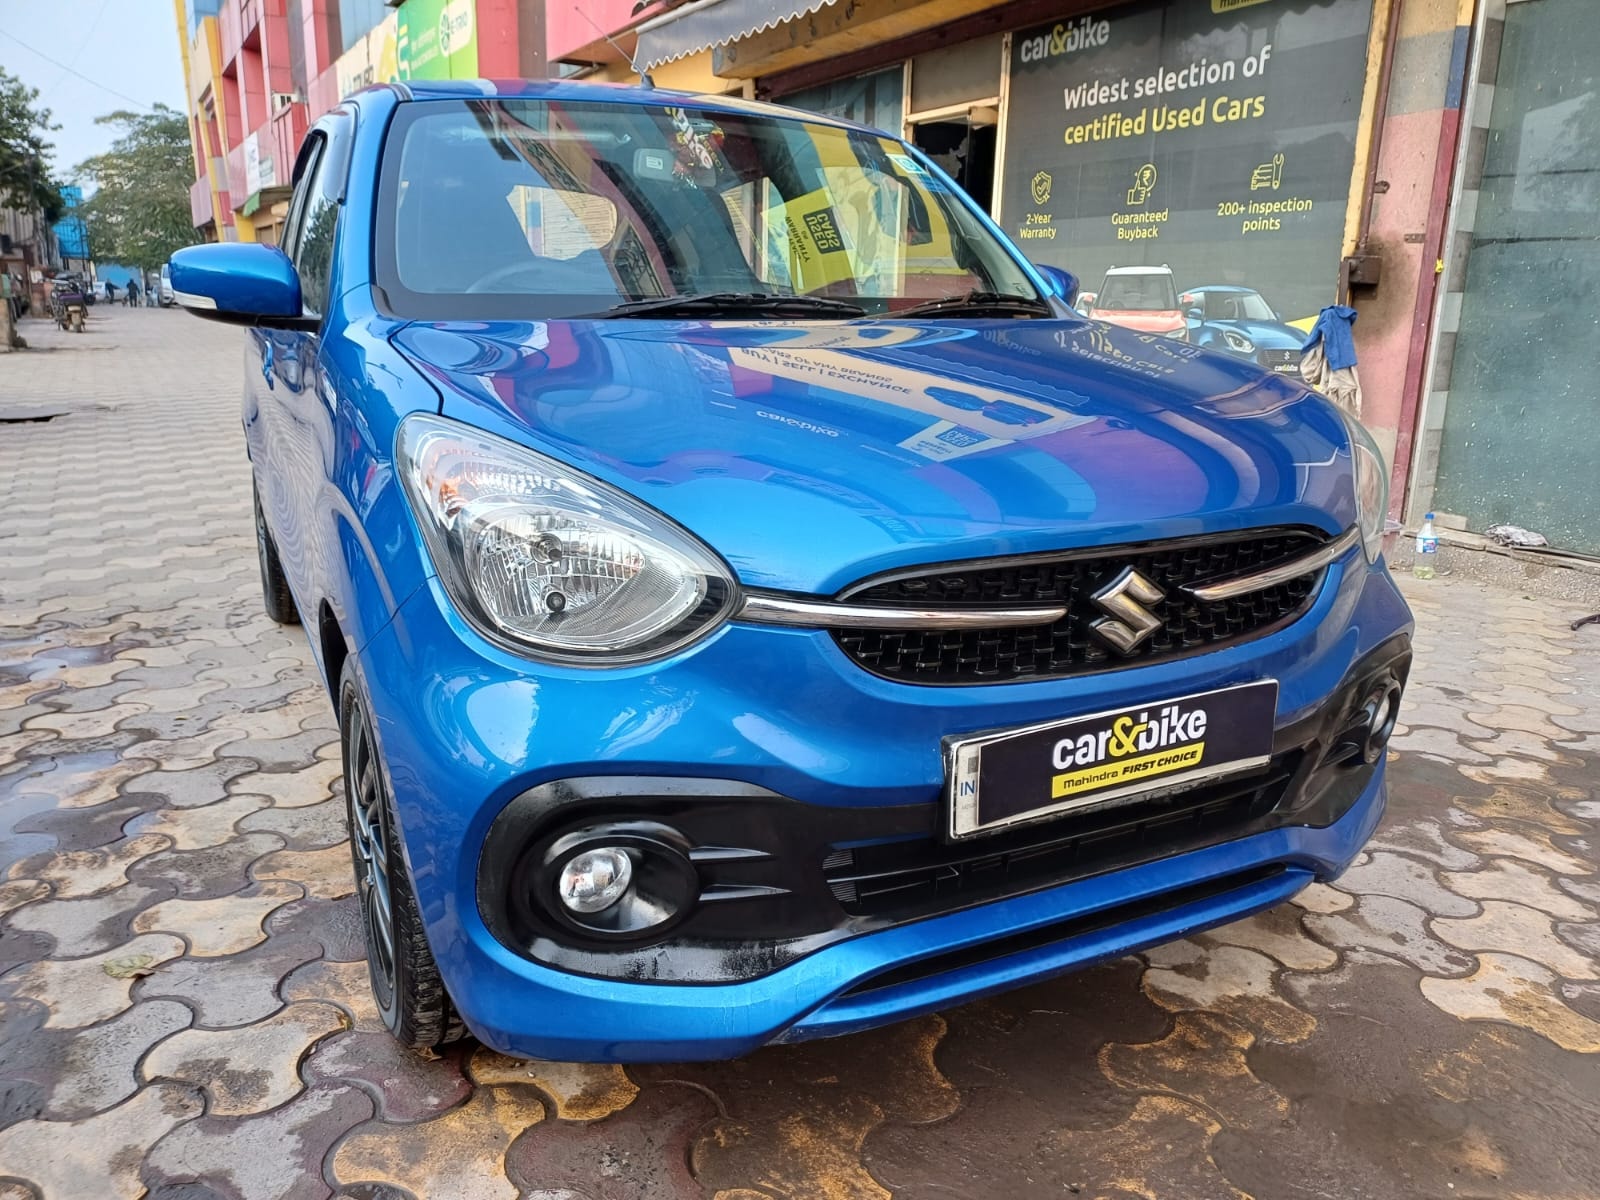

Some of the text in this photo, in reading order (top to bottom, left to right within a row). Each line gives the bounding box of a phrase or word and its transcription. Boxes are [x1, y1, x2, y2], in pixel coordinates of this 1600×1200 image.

[1021, 16, 1110, 62] car&bike
[1064, 44, 1272, 110] Widest selection of
[1064, 95, 1265, 145] certified Used Cars
[1217, 197, 1313, 216] 200+ inspection
[1026, 213, 1052, 225] 2-Year
[1111, 208, 1169, 225] Guaranteed
[1020, 228, 1056, 240] Warranty
[1117, 225, 1159, 242] Buyback
[1242, 217, 1281, 235] points
[1052, 705, 1207, 770] car&bike
[1063, 750, 1199, 789] Mahindra FIRST CHOICE
[961, 780, 976, 797] IN
